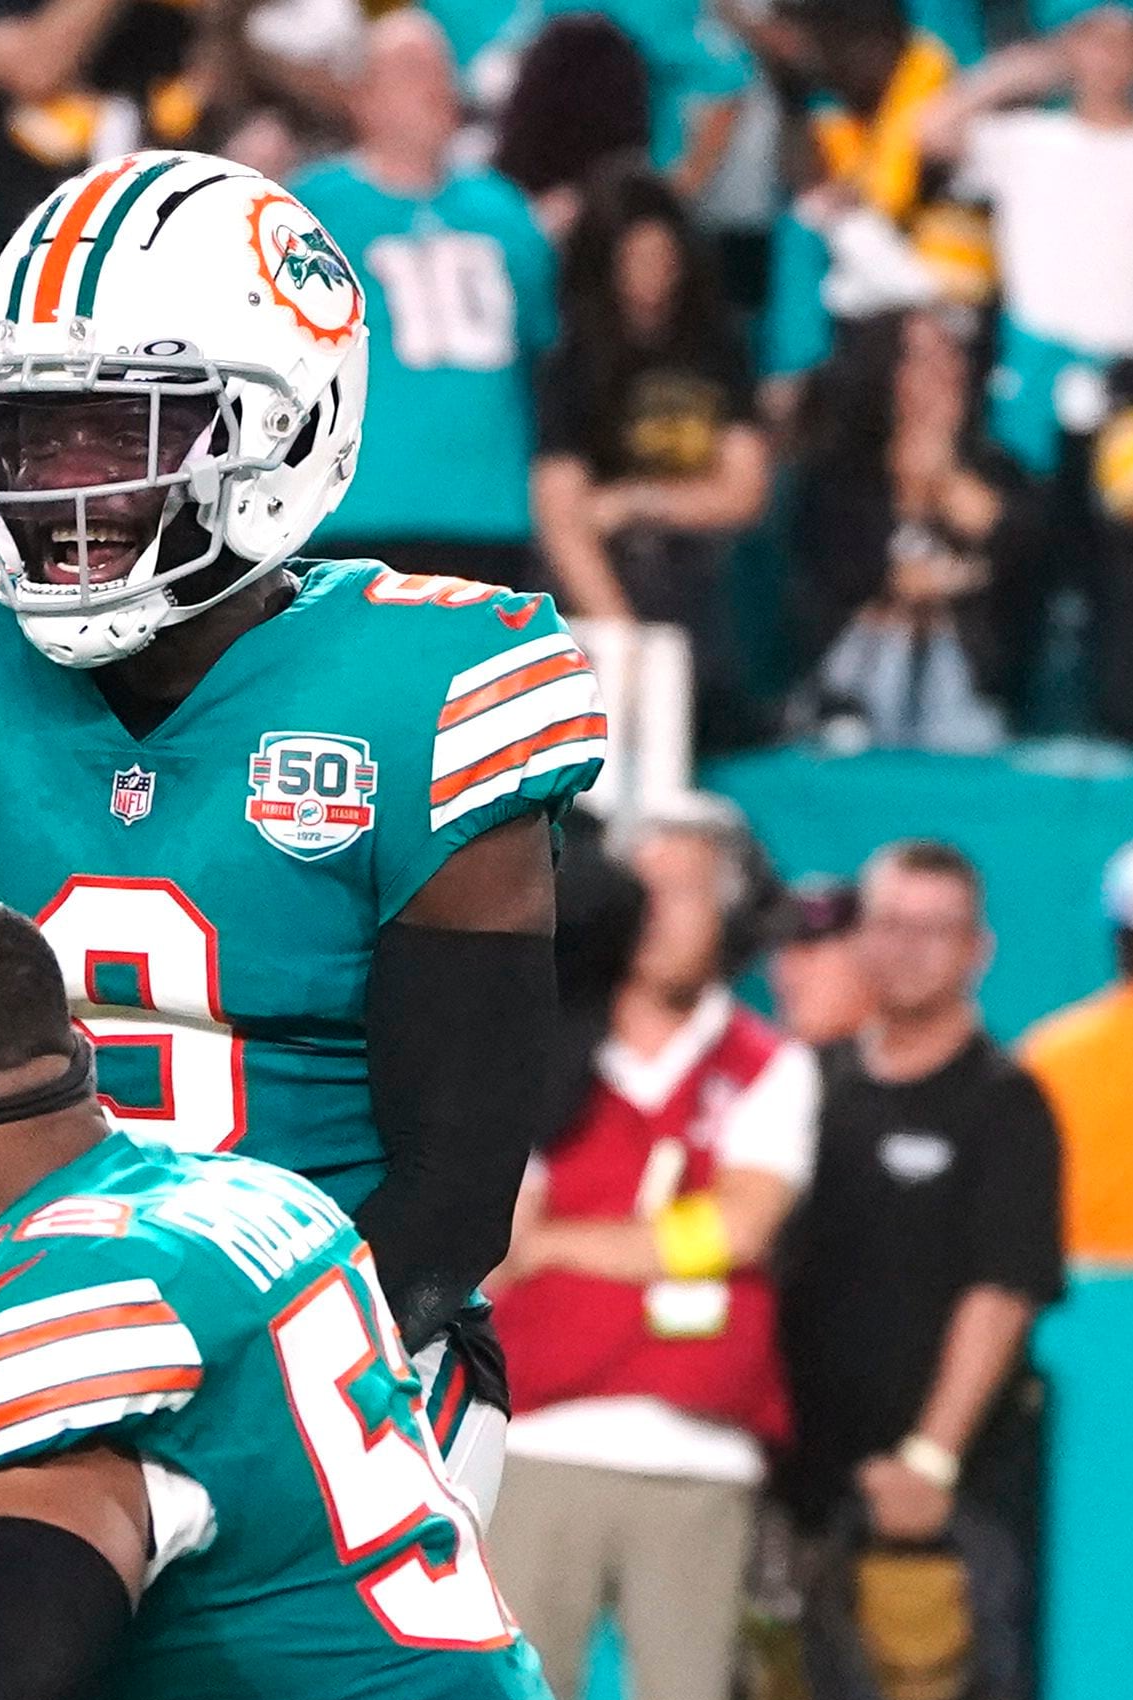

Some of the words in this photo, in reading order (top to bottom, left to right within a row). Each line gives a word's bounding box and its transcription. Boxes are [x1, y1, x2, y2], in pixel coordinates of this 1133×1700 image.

[278, 749, 348, 798] 50
[117, 791, 144, 814] NFL
[296, 831, 322, 841] 1972
